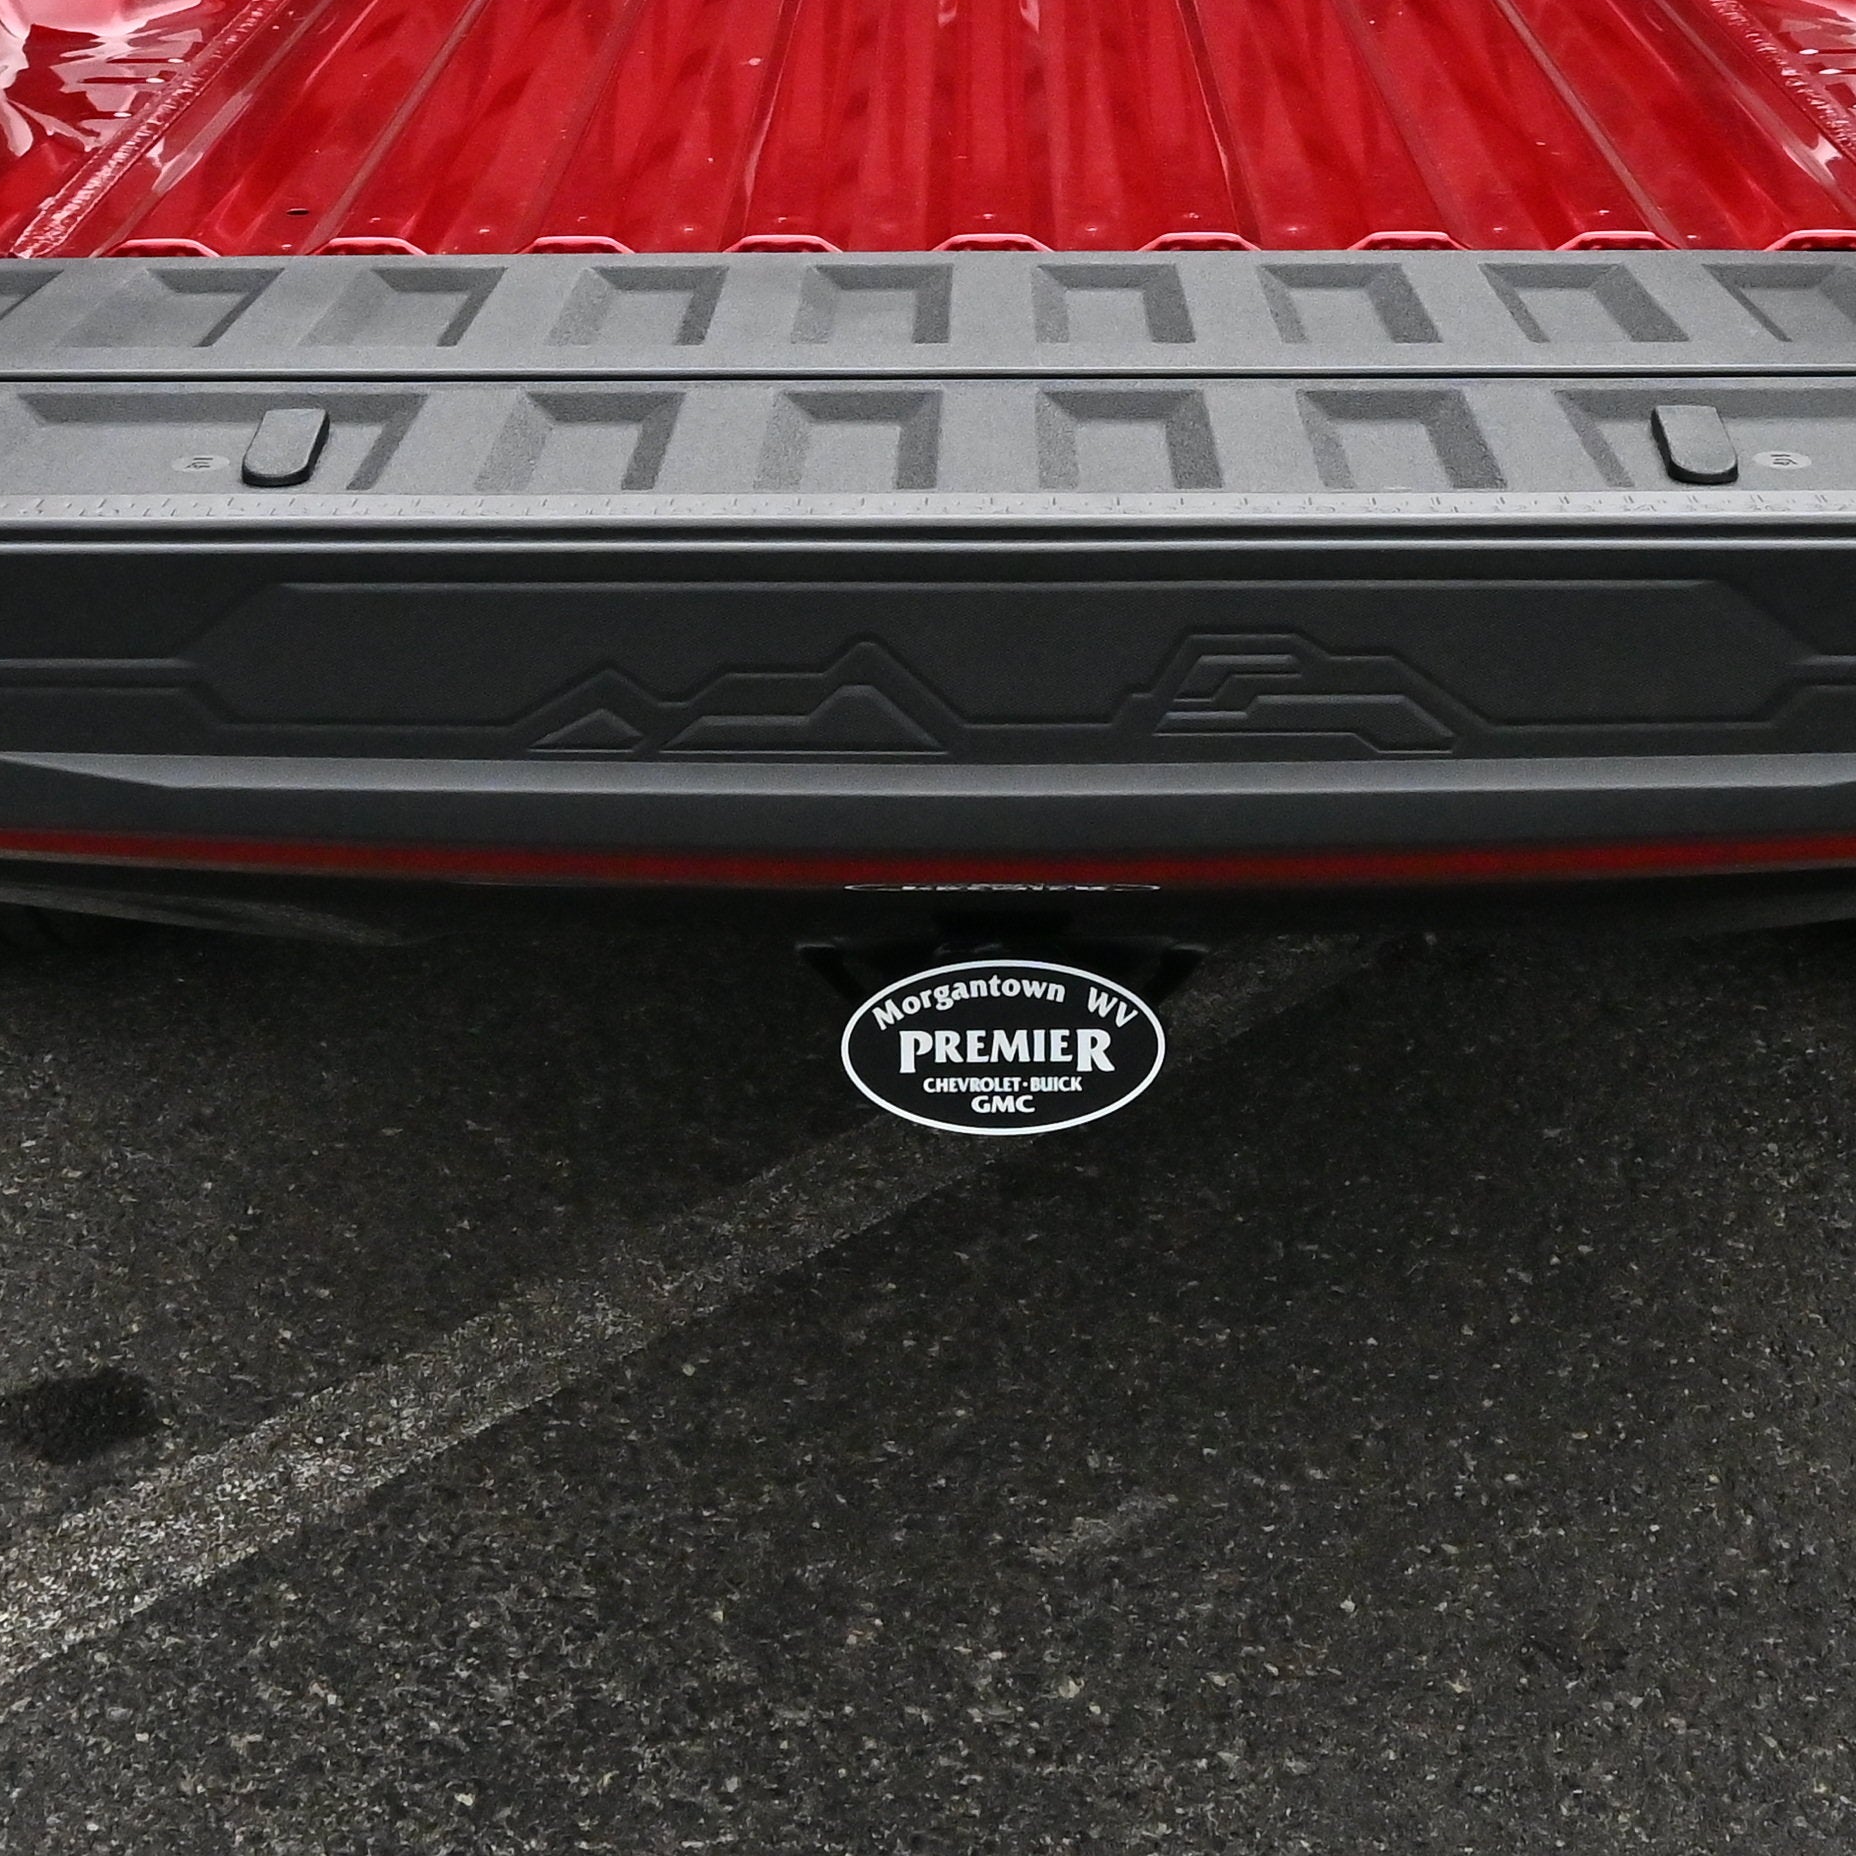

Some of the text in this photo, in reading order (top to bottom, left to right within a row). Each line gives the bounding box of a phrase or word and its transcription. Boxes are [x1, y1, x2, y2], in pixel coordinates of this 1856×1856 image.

[872, 974, 1139, 1031] Morgantown WV
[899, 1028, 1115, 1074] PREMIER
[971, 1094, 1035, 1114] GMC
